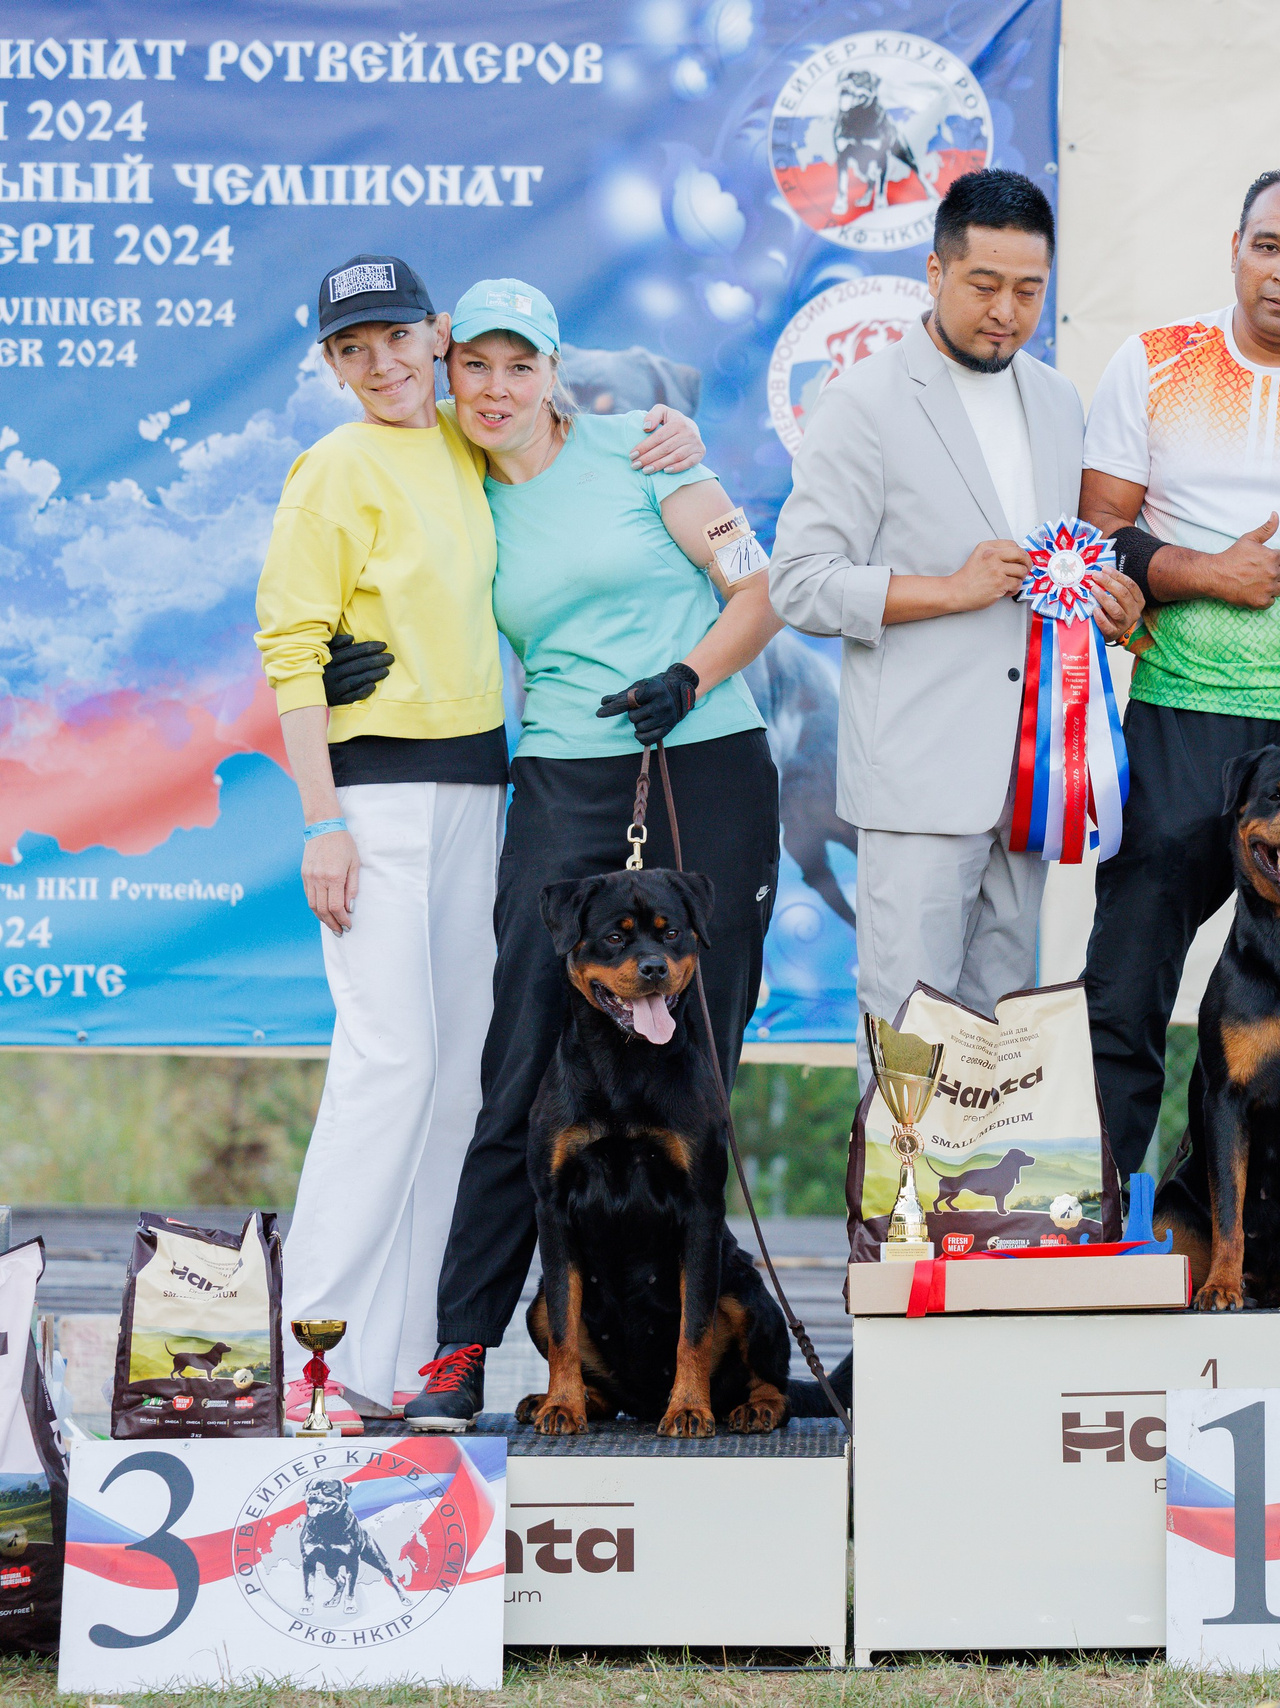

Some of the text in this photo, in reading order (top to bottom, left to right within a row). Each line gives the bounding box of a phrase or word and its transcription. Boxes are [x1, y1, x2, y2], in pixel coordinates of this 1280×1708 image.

[204, 33, 603, 84] РОТВЕЙЛЕРОВ
[876, 38, 949, 72] КЛУБ
[27, 100, 148, 141] 2024
[172, 164, 544, 206] ЧЕМПИОНАТ
[114, 224, 235, 265] 2024
[833, 279, 883, 303] 2024
[156, 298, 236, 327] 2024
[57, 339, 138, 367] 2024
[1072, 716, 1080, 761] класса
[36, 877, 99, 899] НКП
[109, 876, 244, 906] Ротвейлер
[0, 916, 52, 949] 24
[0, 963, 127, 998] ЕСТЕ
[1016, 1027, 1028, 1035] для
[934, 1066, 1043, 1109] Hanta
[931, 1111, 1034, 1150] SMALL/MEDIUM
[948, 1237, 968, 1245] FRESH
[948, 1244, 965, 1252] MEAT
[236, 1454, 327, 1595] РОТВЕЙЛЕР
[346, 1450, 424, 1482] КЛУБ
[428, 1486, 463, 1595] РОССИИ
[88, 1450, 200, 1650] 3
[288, 1614, 414, 1646] РКФ-НКПР
